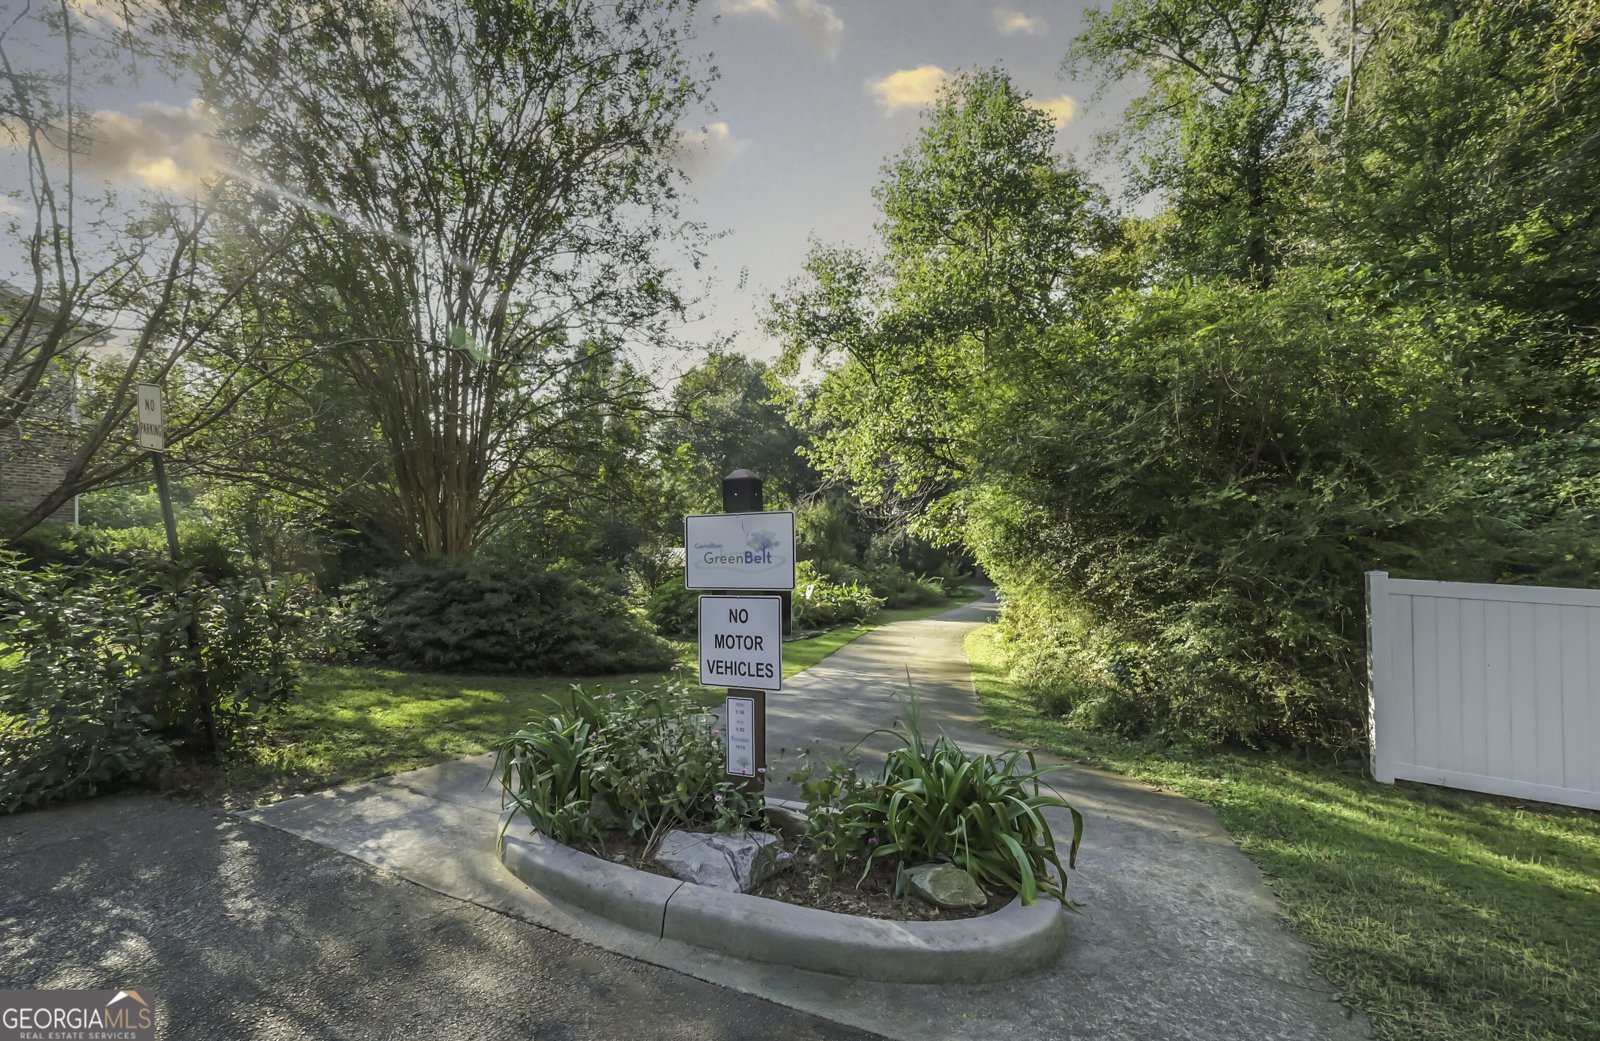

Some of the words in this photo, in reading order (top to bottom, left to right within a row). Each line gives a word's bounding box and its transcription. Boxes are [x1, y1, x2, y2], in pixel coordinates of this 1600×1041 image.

[145, 398, 155, 411] NO
[703, 550, 772, 564] GreenBelt
[729, 608, 749, 623] NO
[714, 633, 764, 651] MOTOR
[706, 659, 774, 678] VEHICLES
